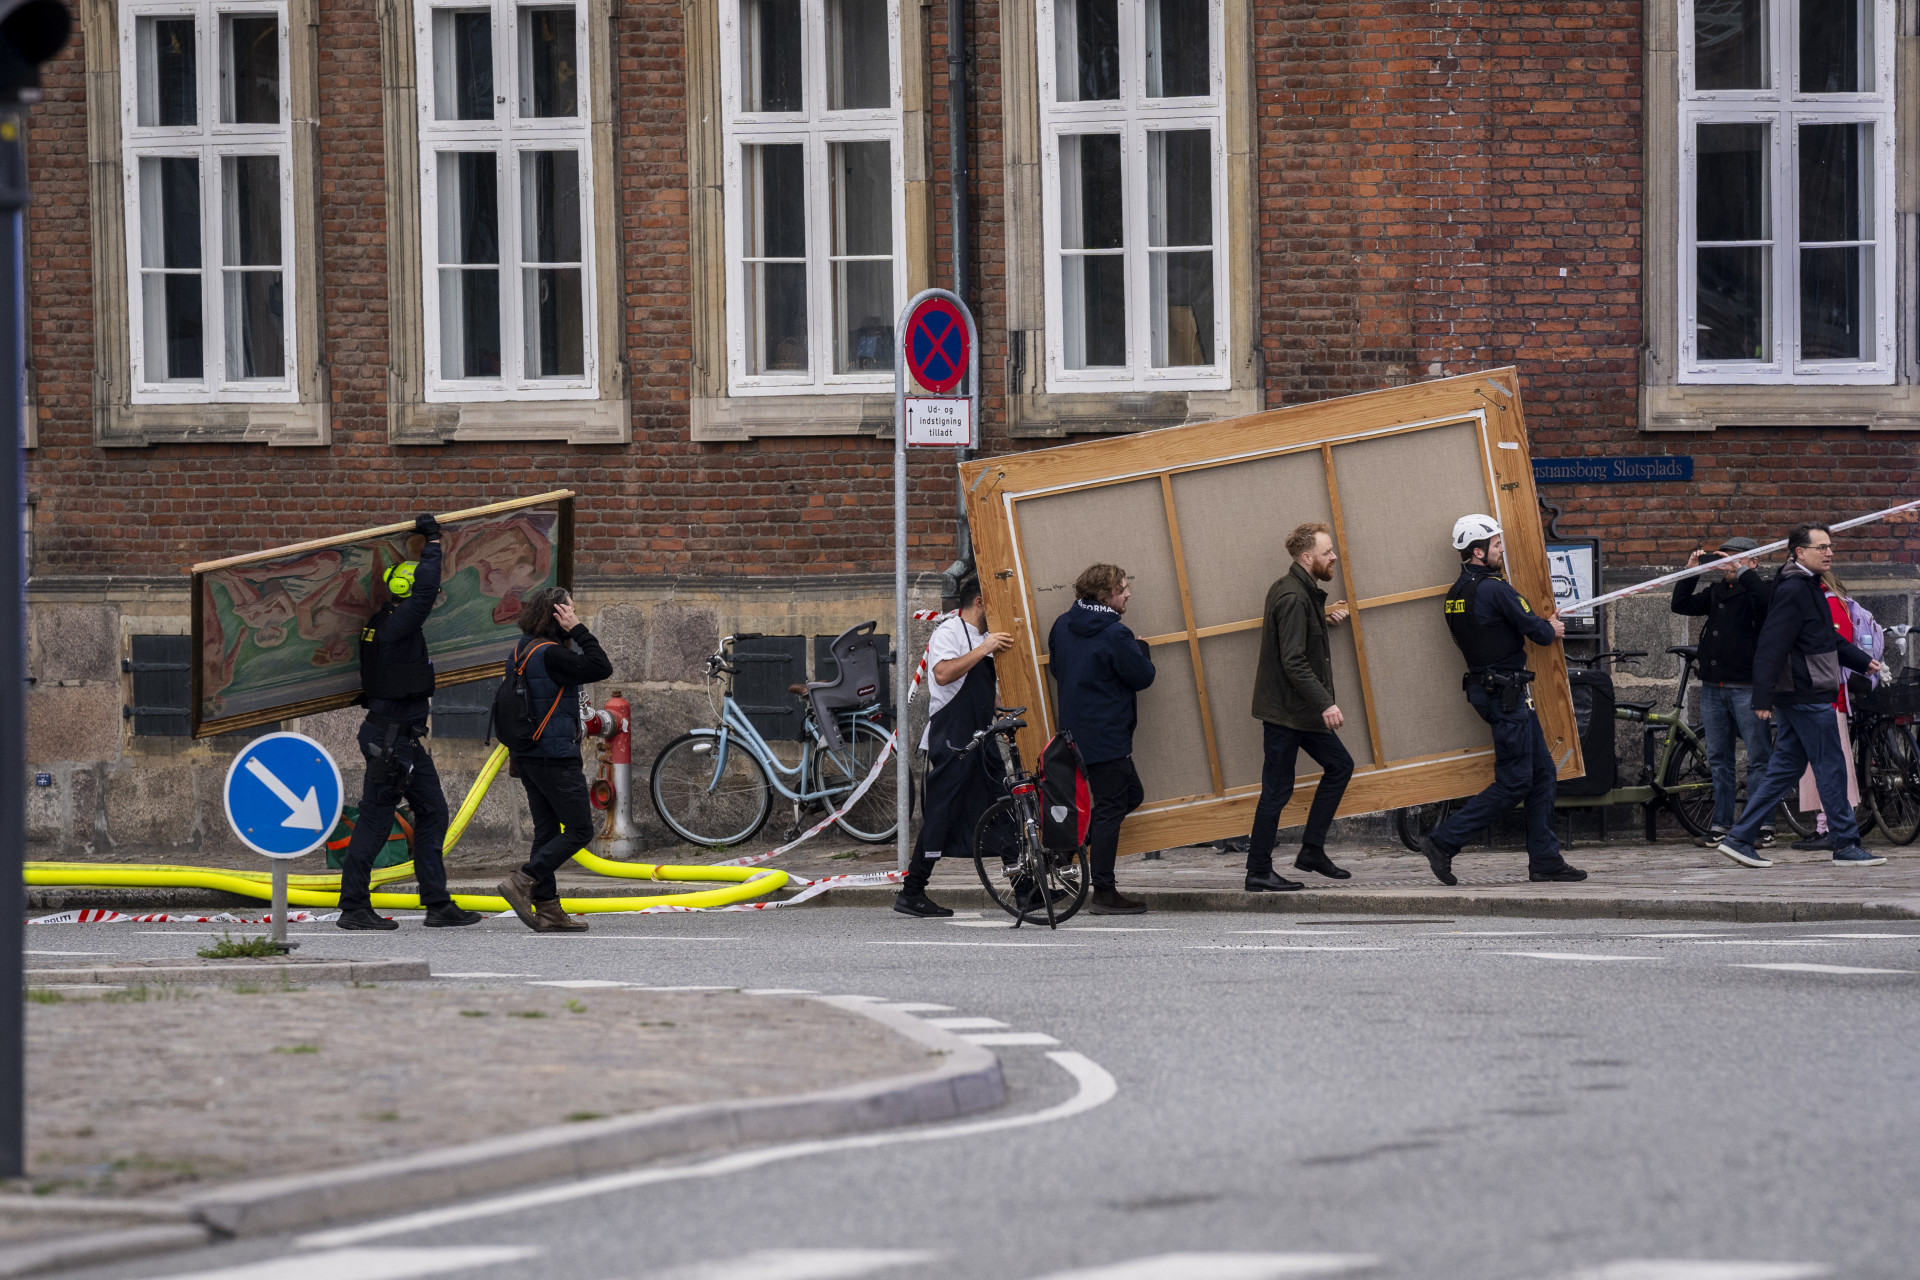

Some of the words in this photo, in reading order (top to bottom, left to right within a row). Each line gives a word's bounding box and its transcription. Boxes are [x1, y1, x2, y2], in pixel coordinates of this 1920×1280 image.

[927, 405, 941, 413] Ud-
[944, 407, 954, 415] og
[919, 416, 962, 427] indstigning
[929, 428, 953, 437] tilladt
[1533, 461, 1607, 480] istiansborg
[1613, 459, 1683, 479] Slotsplads
